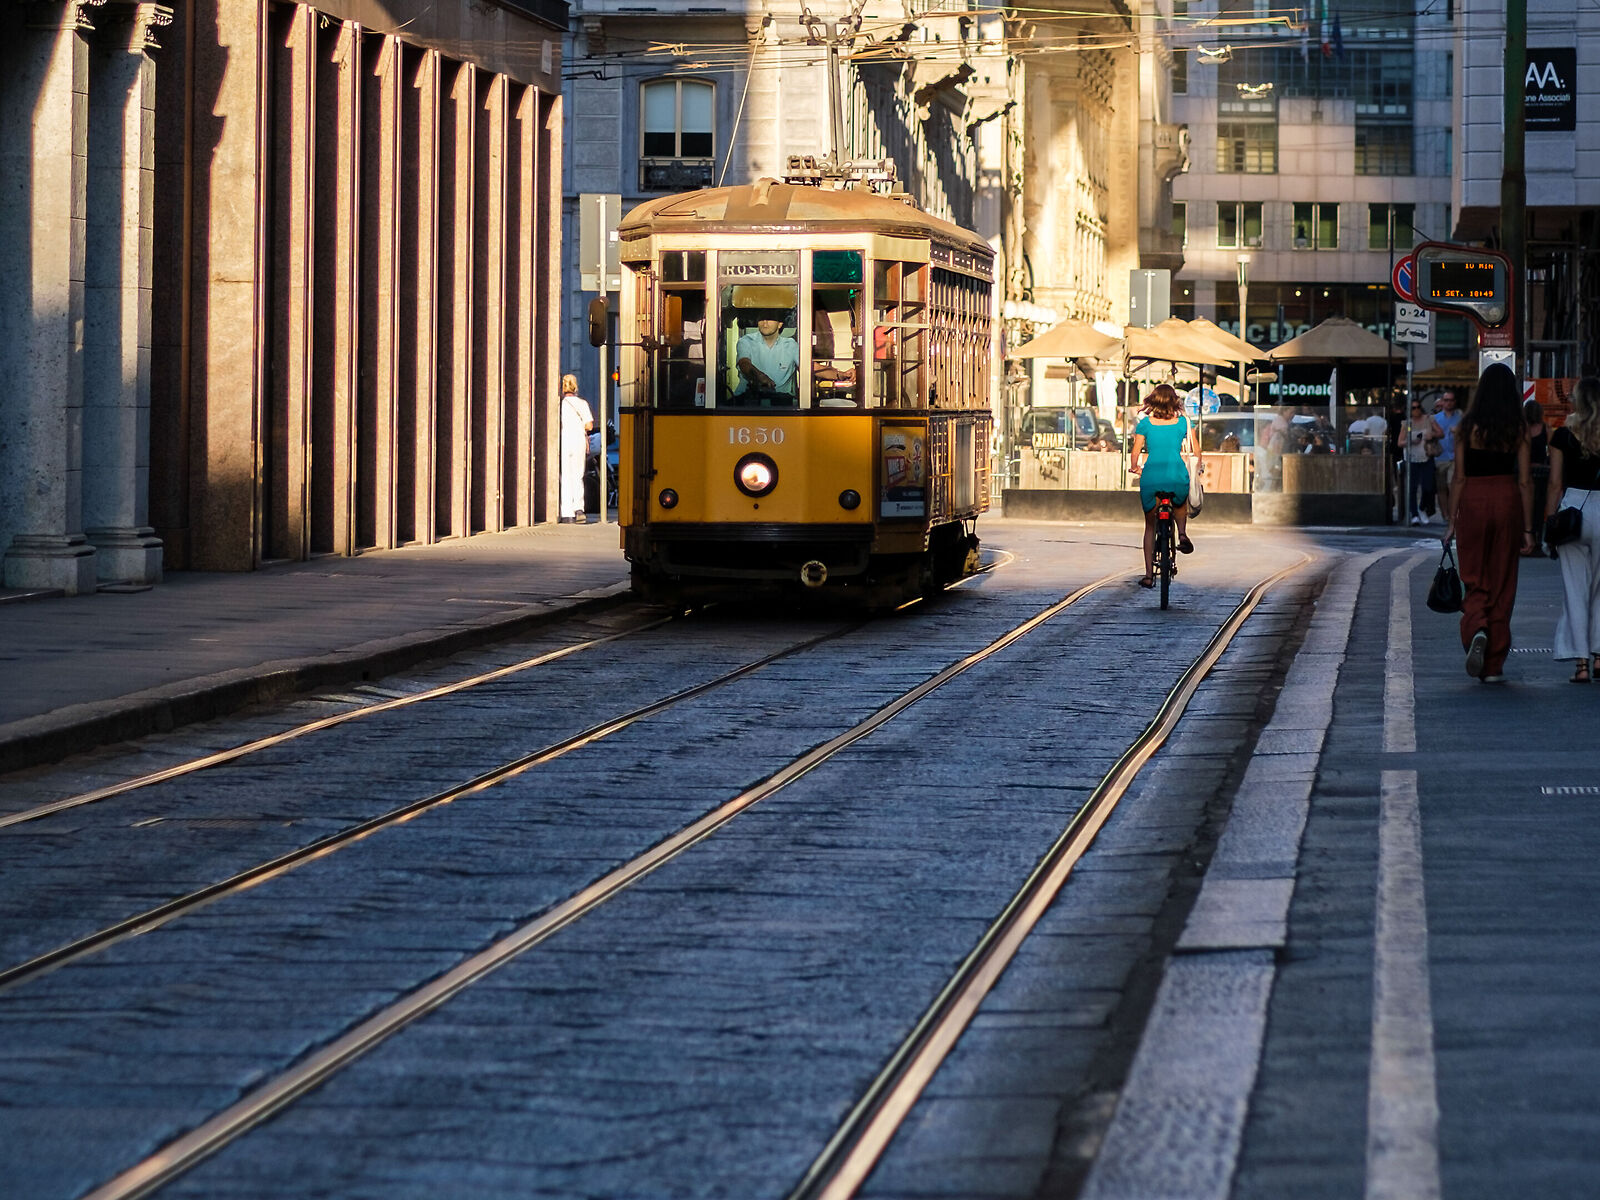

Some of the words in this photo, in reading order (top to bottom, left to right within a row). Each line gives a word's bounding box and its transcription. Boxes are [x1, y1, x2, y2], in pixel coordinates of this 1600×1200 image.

[1538, 93, 1570, 102] Associati
[726, 265, 794, 275] ROSERIO
[729, 427, 784, 445] 1650
